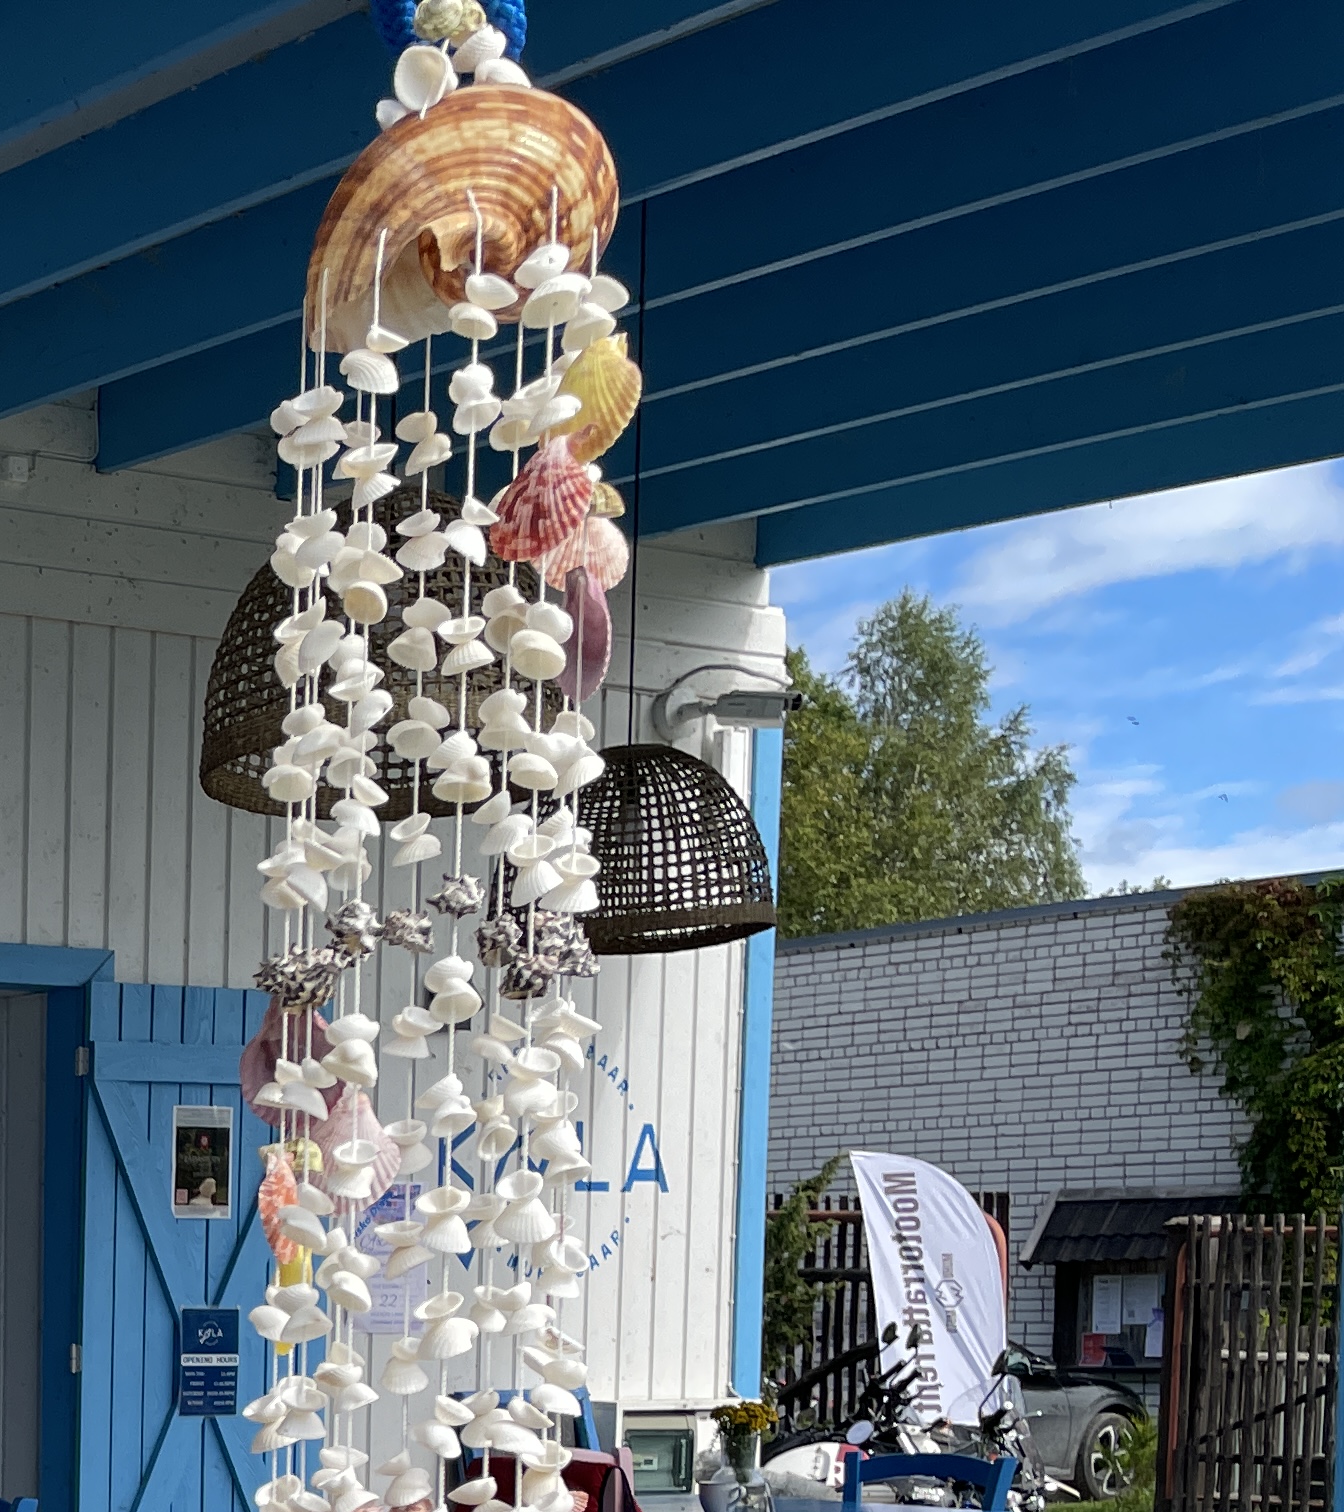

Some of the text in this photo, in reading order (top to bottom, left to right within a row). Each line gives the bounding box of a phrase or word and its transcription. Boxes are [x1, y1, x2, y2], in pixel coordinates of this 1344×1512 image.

[379, 1293, 398, 1308] 22
[182, 1356, 238, 1364] OPENING HOURS
